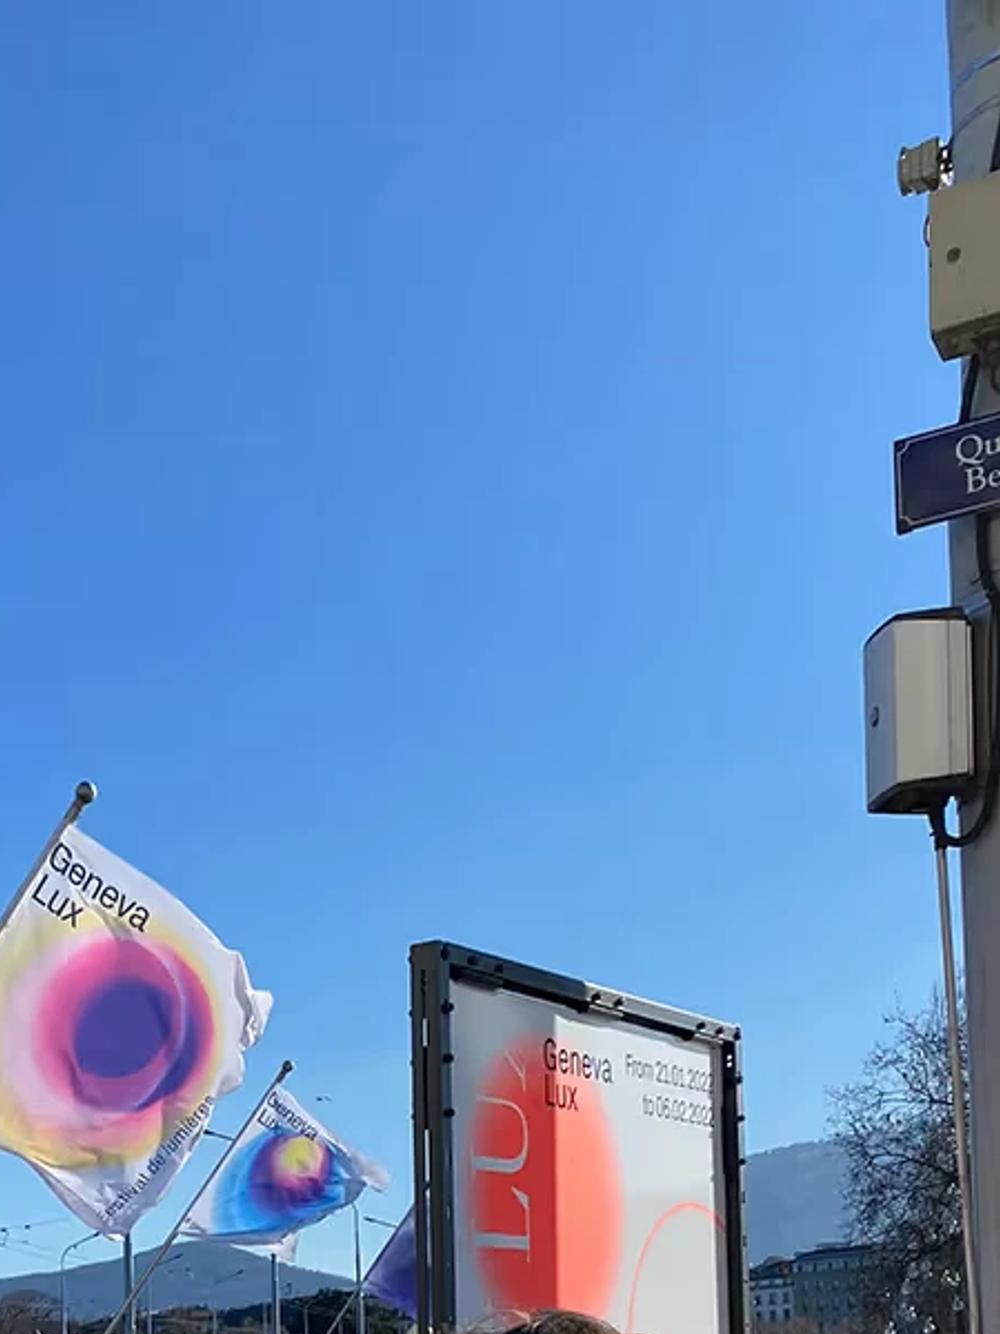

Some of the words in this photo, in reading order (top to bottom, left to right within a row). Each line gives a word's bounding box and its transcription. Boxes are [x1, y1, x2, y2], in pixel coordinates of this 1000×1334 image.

[31, 873, 84, 928] Lux
[49, 841, 151, 933] Geneva
[543, 1037, 615, 1084] Geneva
[625, 1052, 655, 1081] From
[265, 1090, 320, 1141] Geneva
[544, 1073, 580, 1112] Lux
[642, 1095, 655, 1116] to
